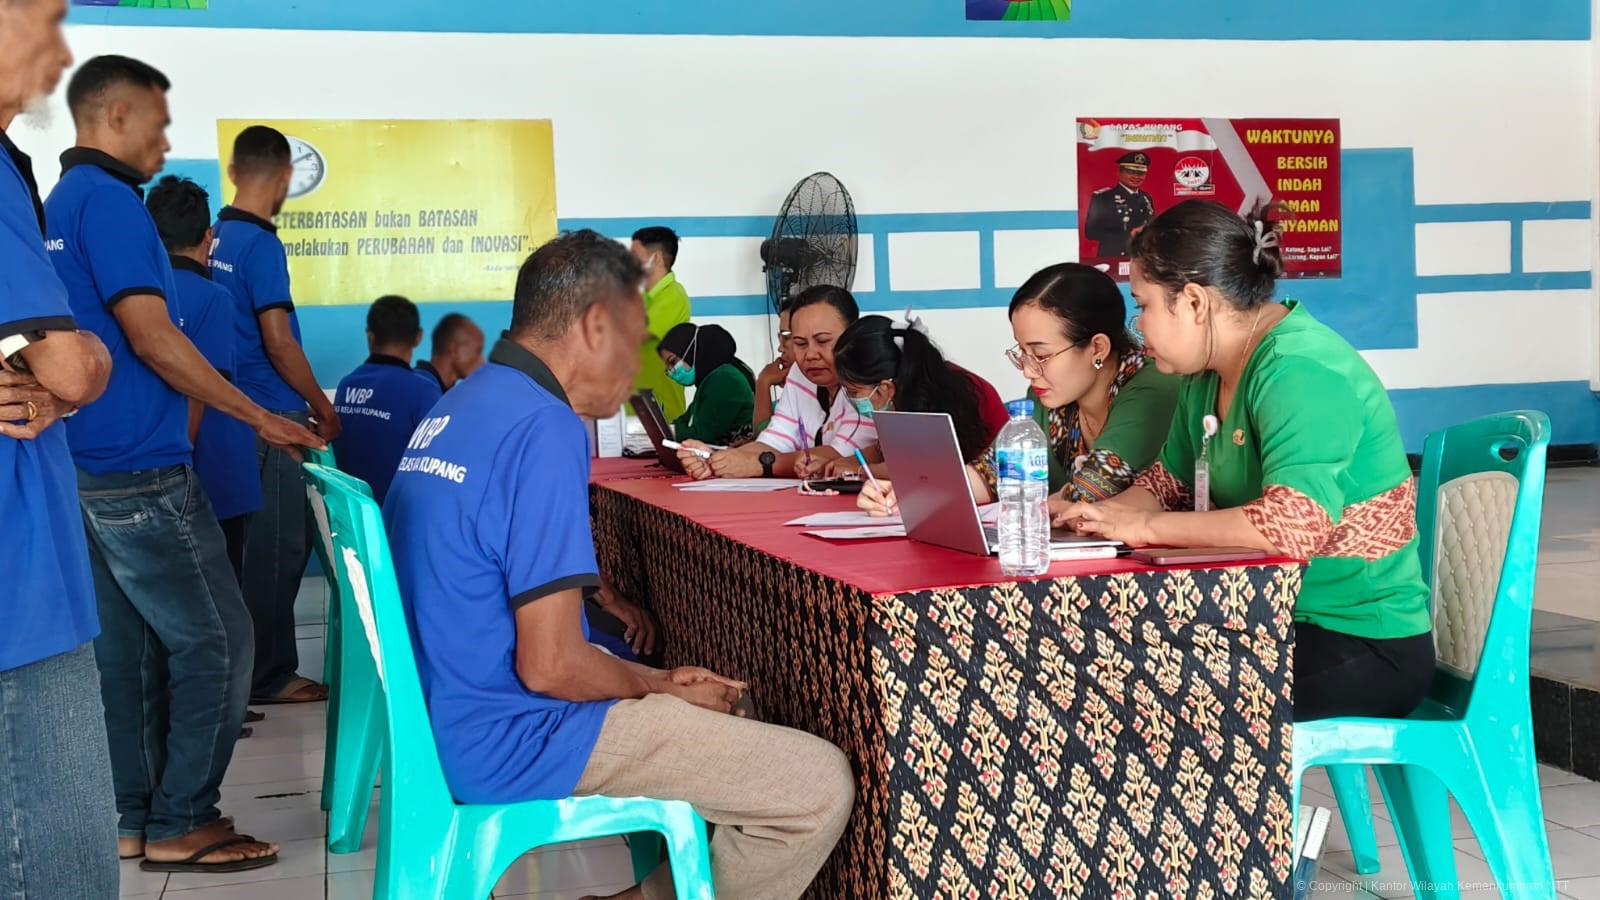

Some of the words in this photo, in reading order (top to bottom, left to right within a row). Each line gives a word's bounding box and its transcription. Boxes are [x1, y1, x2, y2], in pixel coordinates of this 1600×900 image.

[1247, 129, 1334, 144] WAKTUNYA
[1277, 156, 1328, 169] BERSIH
[1277, 178, 1322, 191] INDAH
[275, 210, 367, 229] ETERBATASAN
[375, 210, 411, 228] bukan
[419, 209, 478, 227] BATASAN
[286, 238, 349, 256] melakukan
[357, 236, 435, 255] PERUBAHAN
[442, 236, 463, 253] dan
[345, 386, 374, 404] WBP
[361, 407, 391, 420] KUPANG
[407, 415, 451, 450] WBP
[418, 456, 467, 483] KUPANG
